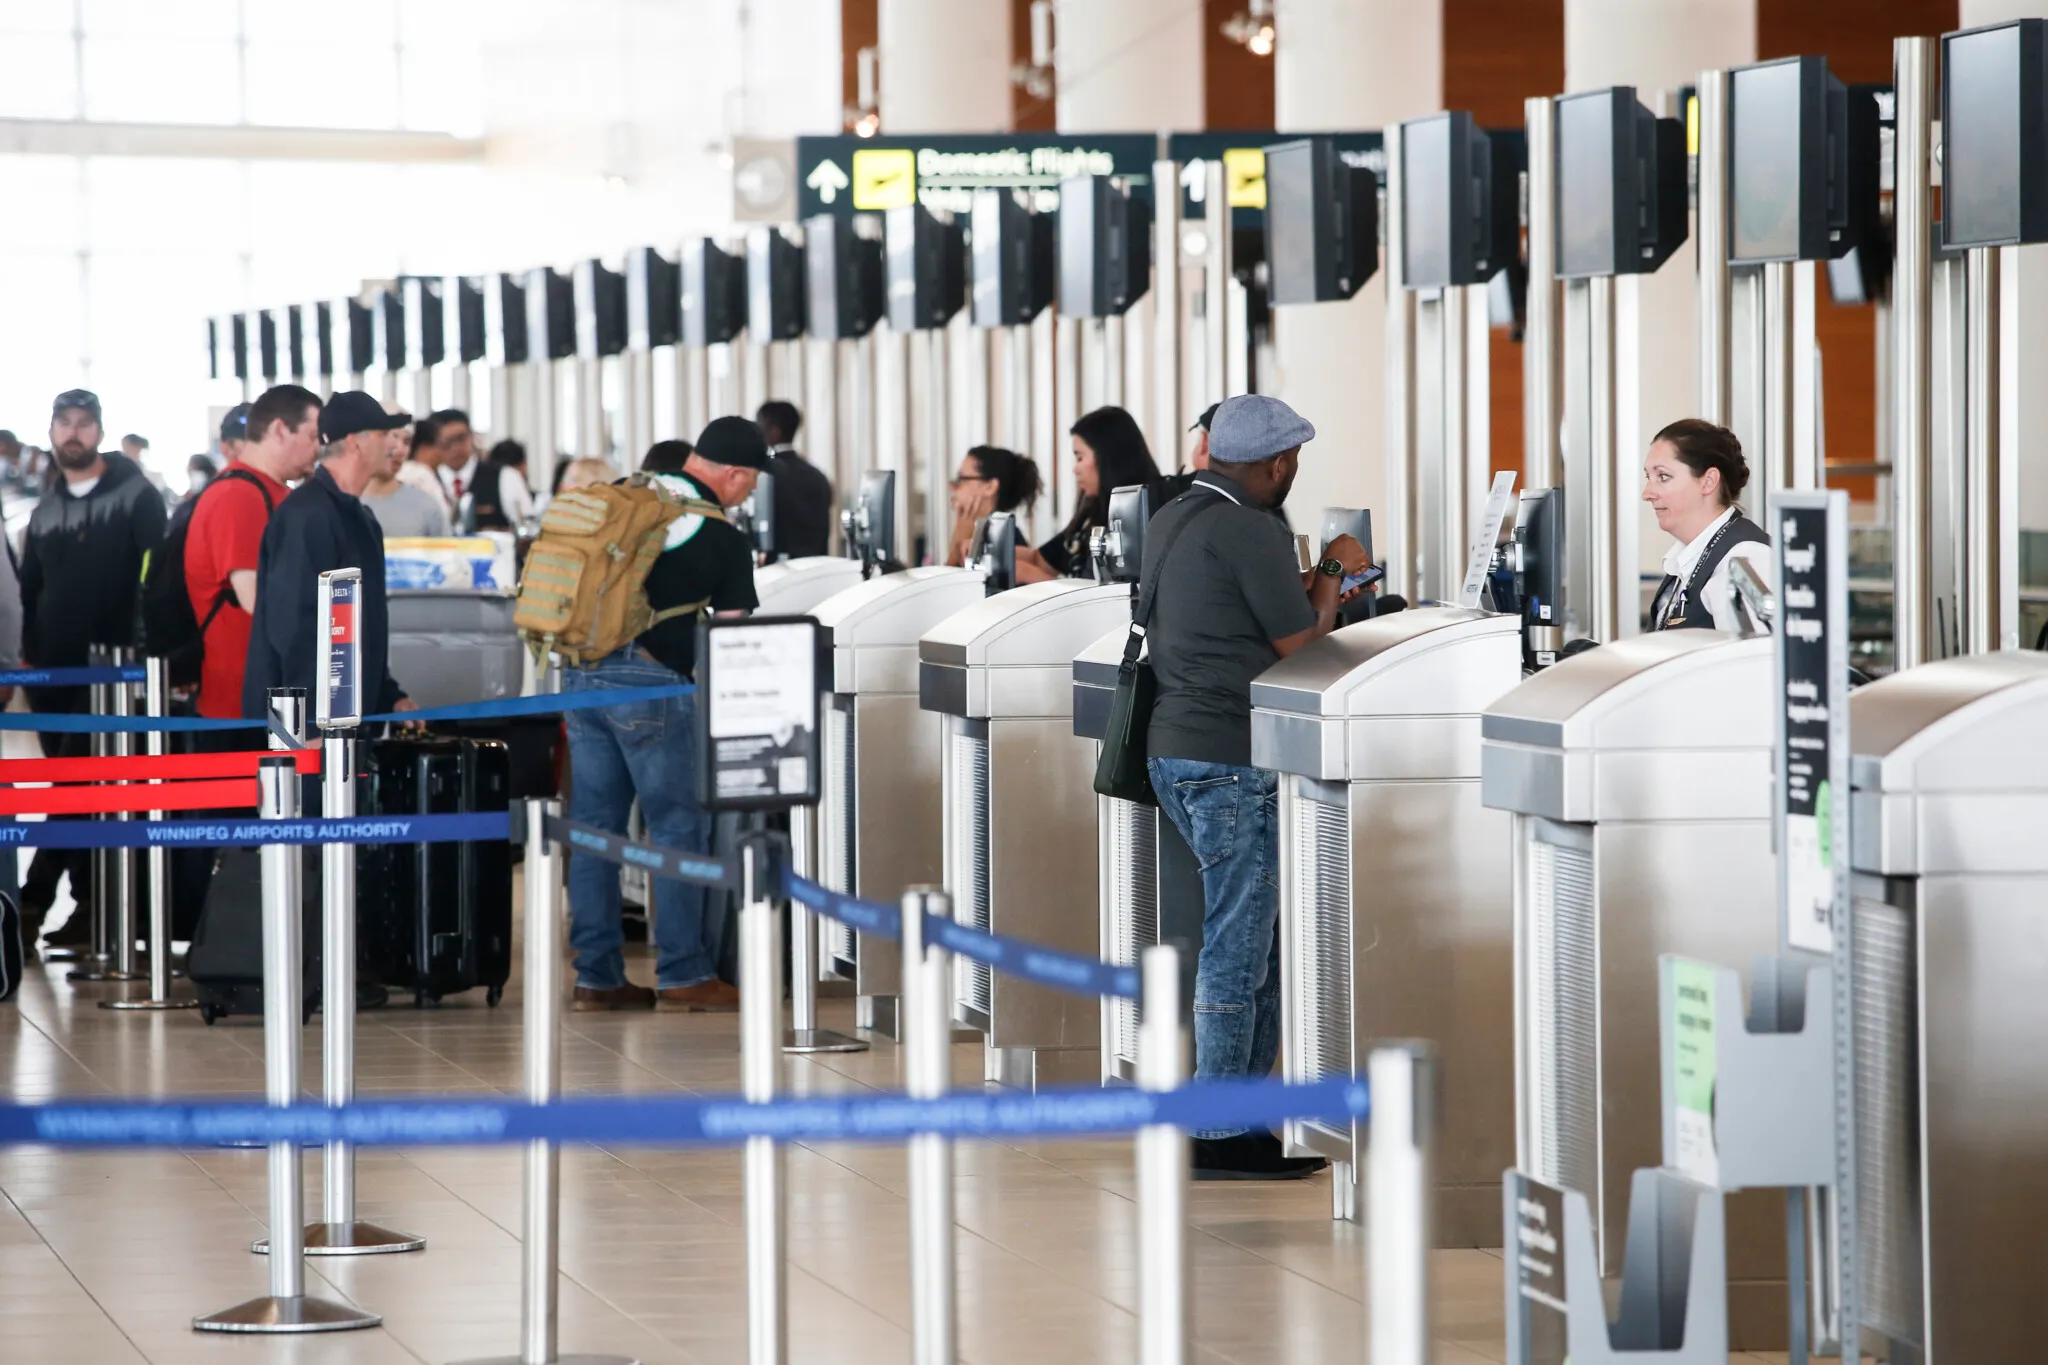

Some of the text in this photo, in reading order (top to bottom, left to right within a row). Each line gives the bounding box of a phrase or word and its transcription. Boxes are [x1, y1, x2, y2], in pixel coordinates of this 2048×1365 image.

[918, 147, 1114, 178] Domestic Flights
[334, 588, 348, 597] DELTA
[147, 822, 411, 841] WINNIPEG AIRPORTS AUTHORITY
